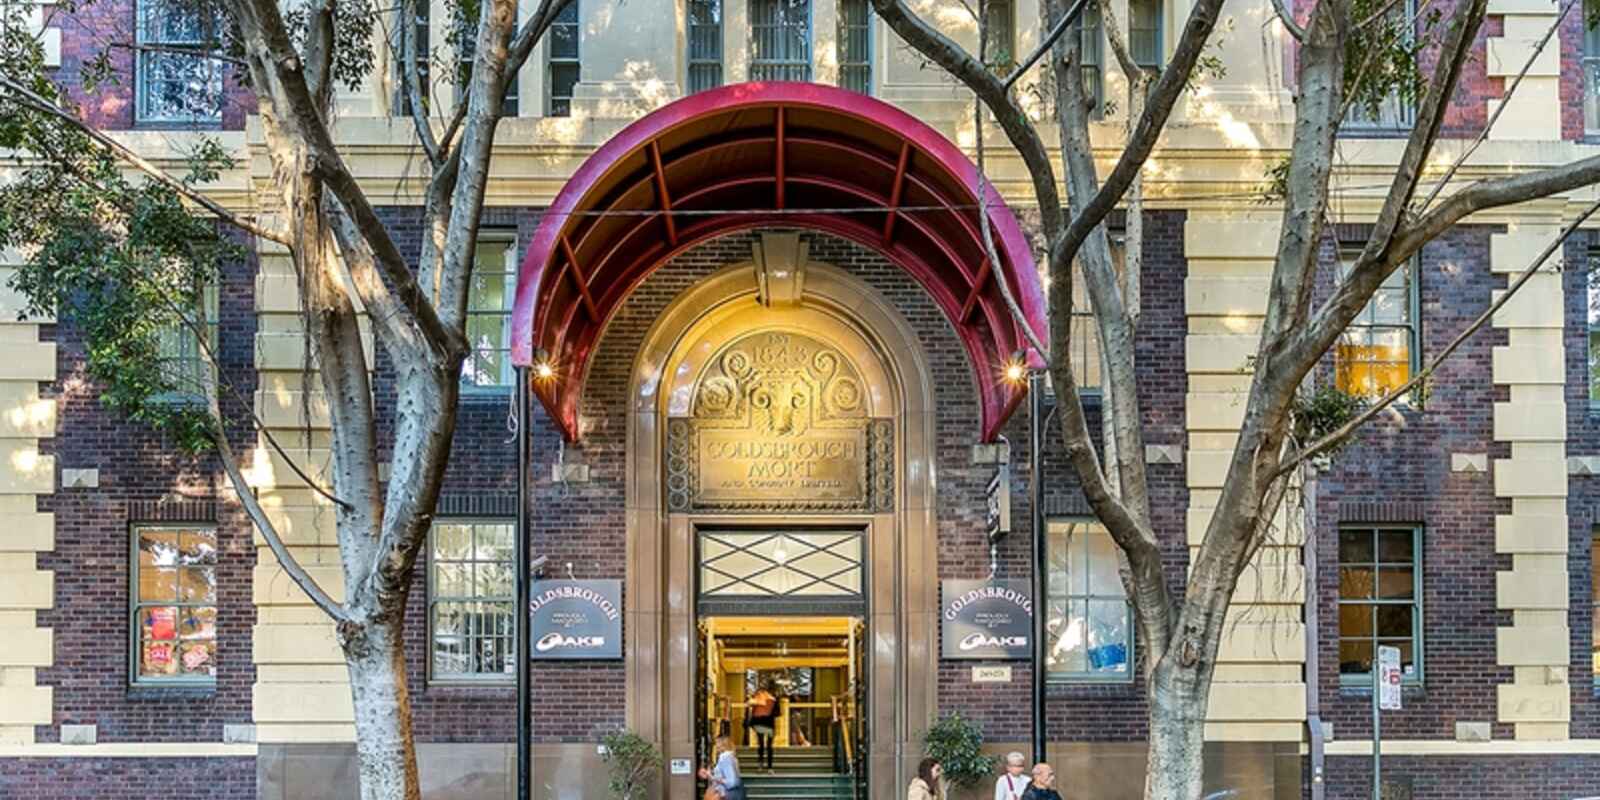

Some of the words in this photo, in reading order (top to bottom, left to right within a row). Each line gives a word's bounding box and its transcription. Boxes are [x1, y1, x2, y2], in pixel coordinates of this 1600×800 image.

[752, 346, 809, 364] 1843
[747, 460, 816, 478] MORT
[530, 586, 619, 621] OLDSBROUGH
[945, 586, 1032, 621] GOLDSBROUG
[536, 632, 605, 651] OAKS
[960, 632, 1027, 650] OAKS
